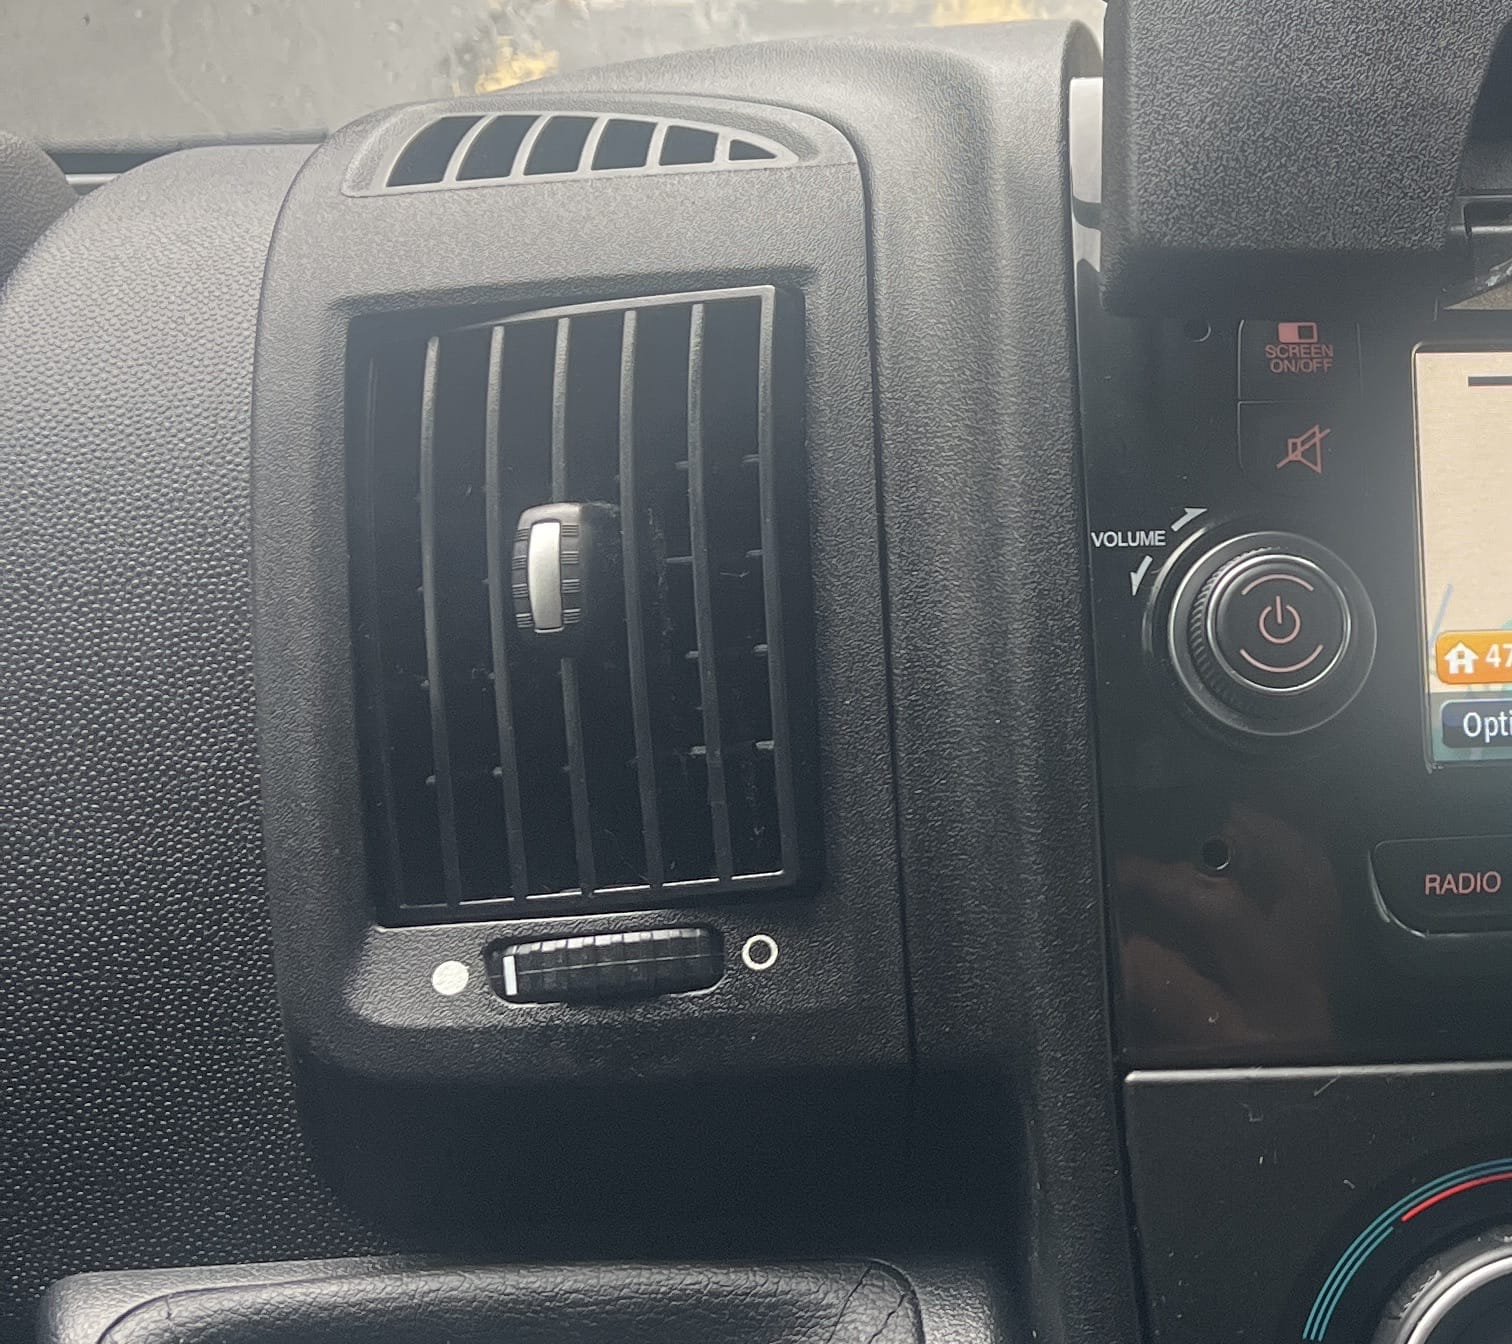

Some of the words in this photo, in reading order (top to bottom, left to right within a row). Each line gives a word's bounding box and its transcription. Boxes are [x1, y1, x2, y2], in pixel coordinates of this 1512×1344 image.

[1264, 343, 1334, 358] SCREEN
[1270, 358, 1333, 373] ON/OFF
[1091, 530, 1167, 548] VOLUME
[1424, 870, 1502, 896] RADIO
